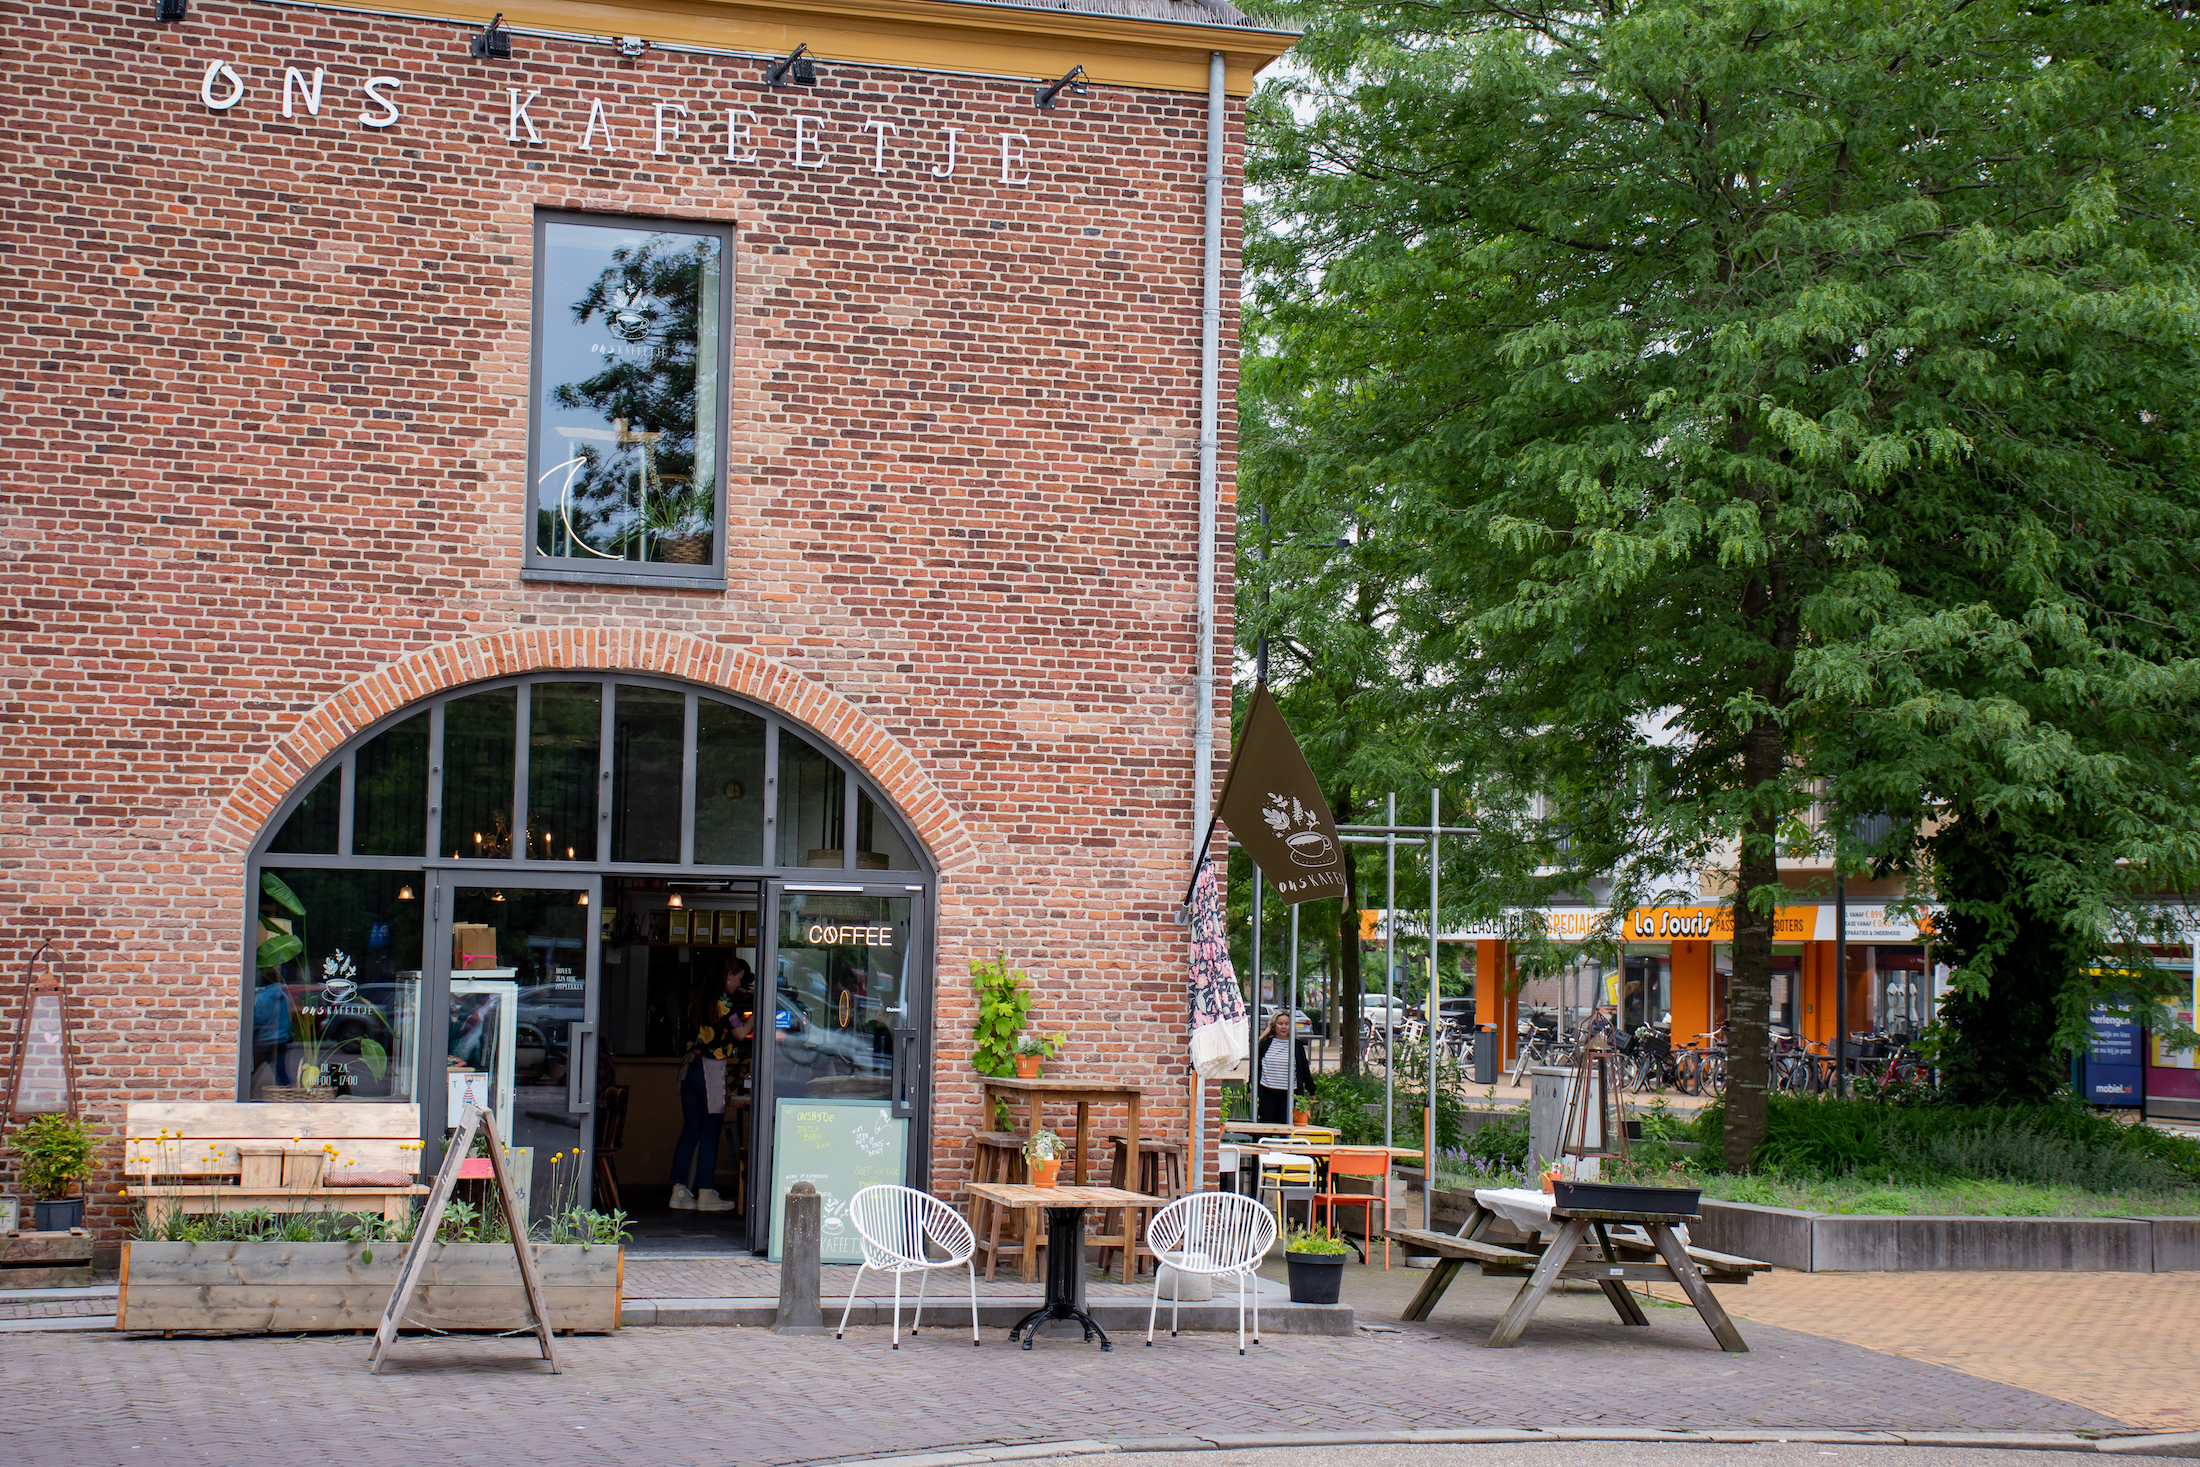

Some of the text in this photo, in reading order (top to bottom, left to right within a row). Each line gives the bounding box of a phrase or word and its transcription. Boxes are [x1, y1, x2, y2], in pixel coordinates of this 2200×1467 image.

[201, 59, 1031, 186] ONS KAFEETJE
[617, 344, 667, 358] KAFEETJE
[1635, 910, 1712, 938] La Souris
[809, 925, 893, 946] COFFEE
[327, 1006, 373, 1015] KAFEETJE
[820, 1237, 865, 1254] KAFEETJ
